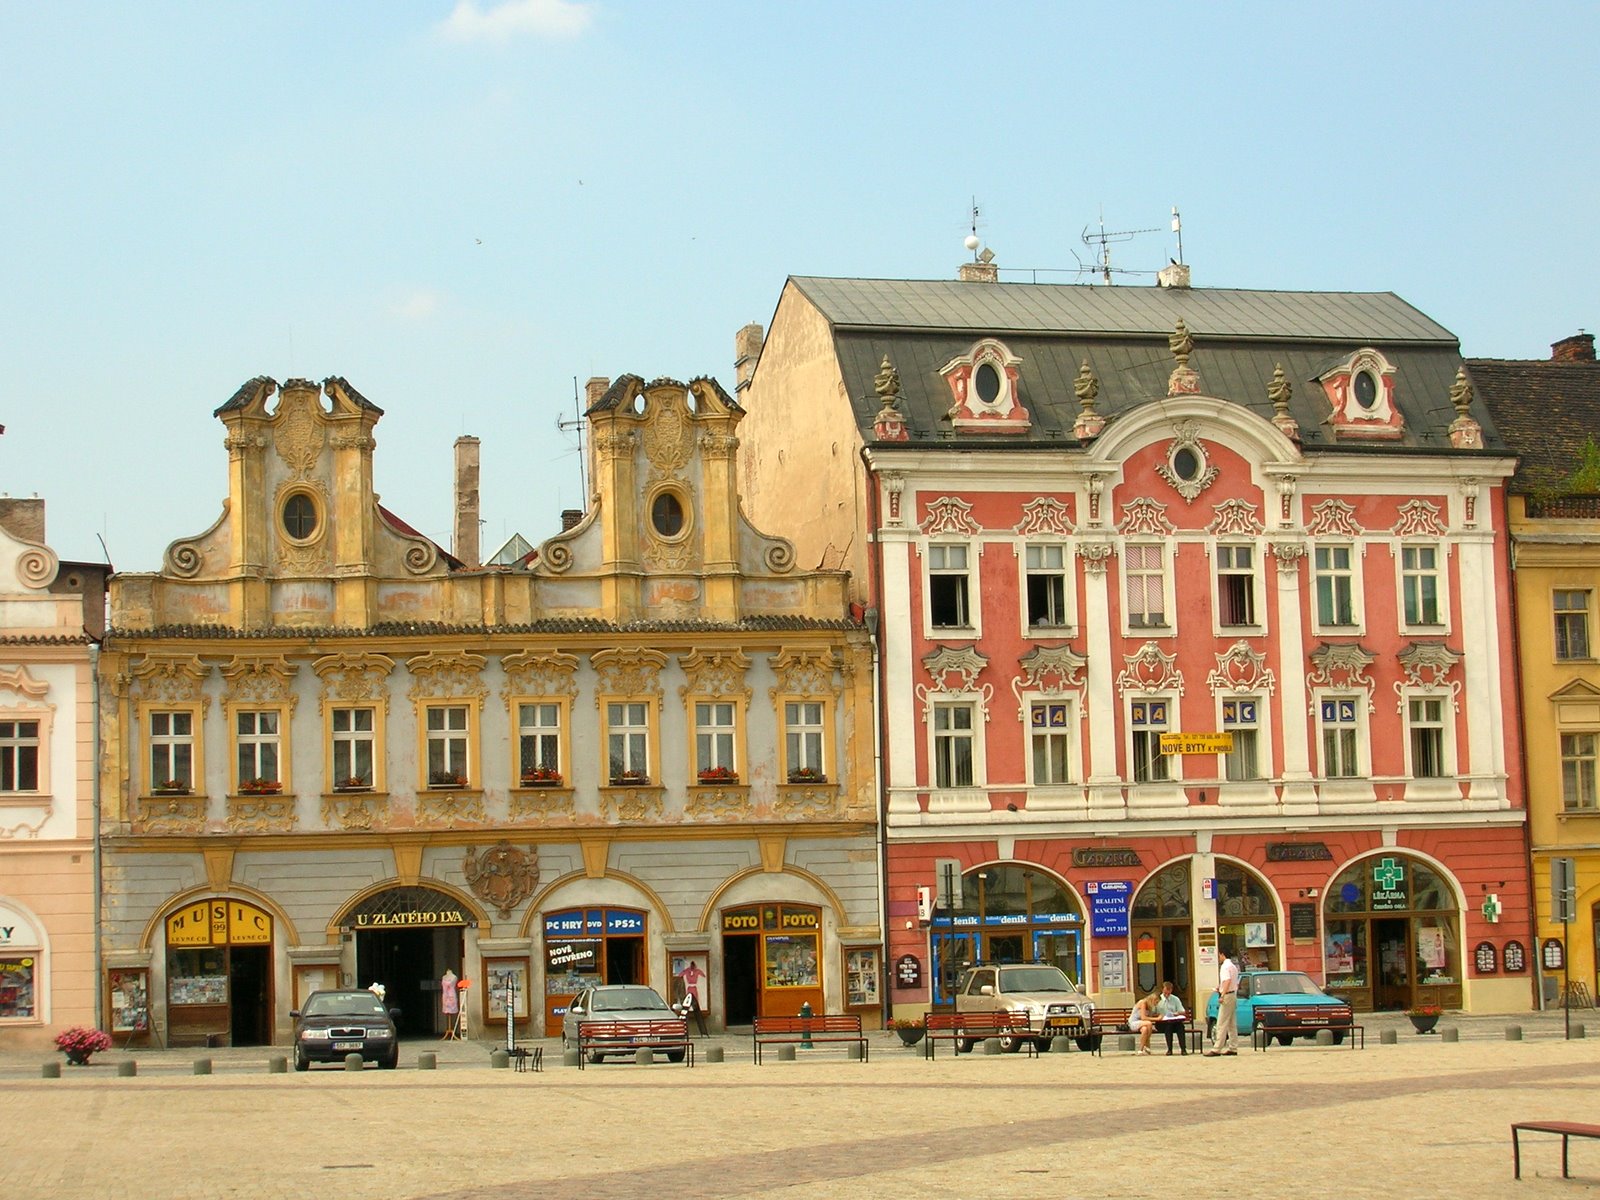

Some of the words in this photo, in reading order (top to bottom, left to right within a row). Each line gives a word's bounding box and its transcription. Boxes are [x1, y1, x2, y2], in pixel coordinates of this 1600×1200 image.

[1186, 743, 1205, 752] BYTY
[1094, 906, 1126, 914] KANCELÁŘ
[173, 906, 265, 933] MUSIC
[357, 914, 367, 925] U
[372, 910, 437, 925] ZLATÉHO
[440, 911, 463, 923] LVA
[724, 916, 758, 928] FOTO
[783, 914, 816, 926] FOTO
[1000, 915, 1027, 924] deník
[1050, 913, 1076, 922] deník
[213, 923, 225, 931] 99
[546, 921, 559, 930] PC
[562, 920, 583, 930] HRY
[614, 919, 635, 928] PS2
[551, 950, 593, 965] OTEVŘENO
